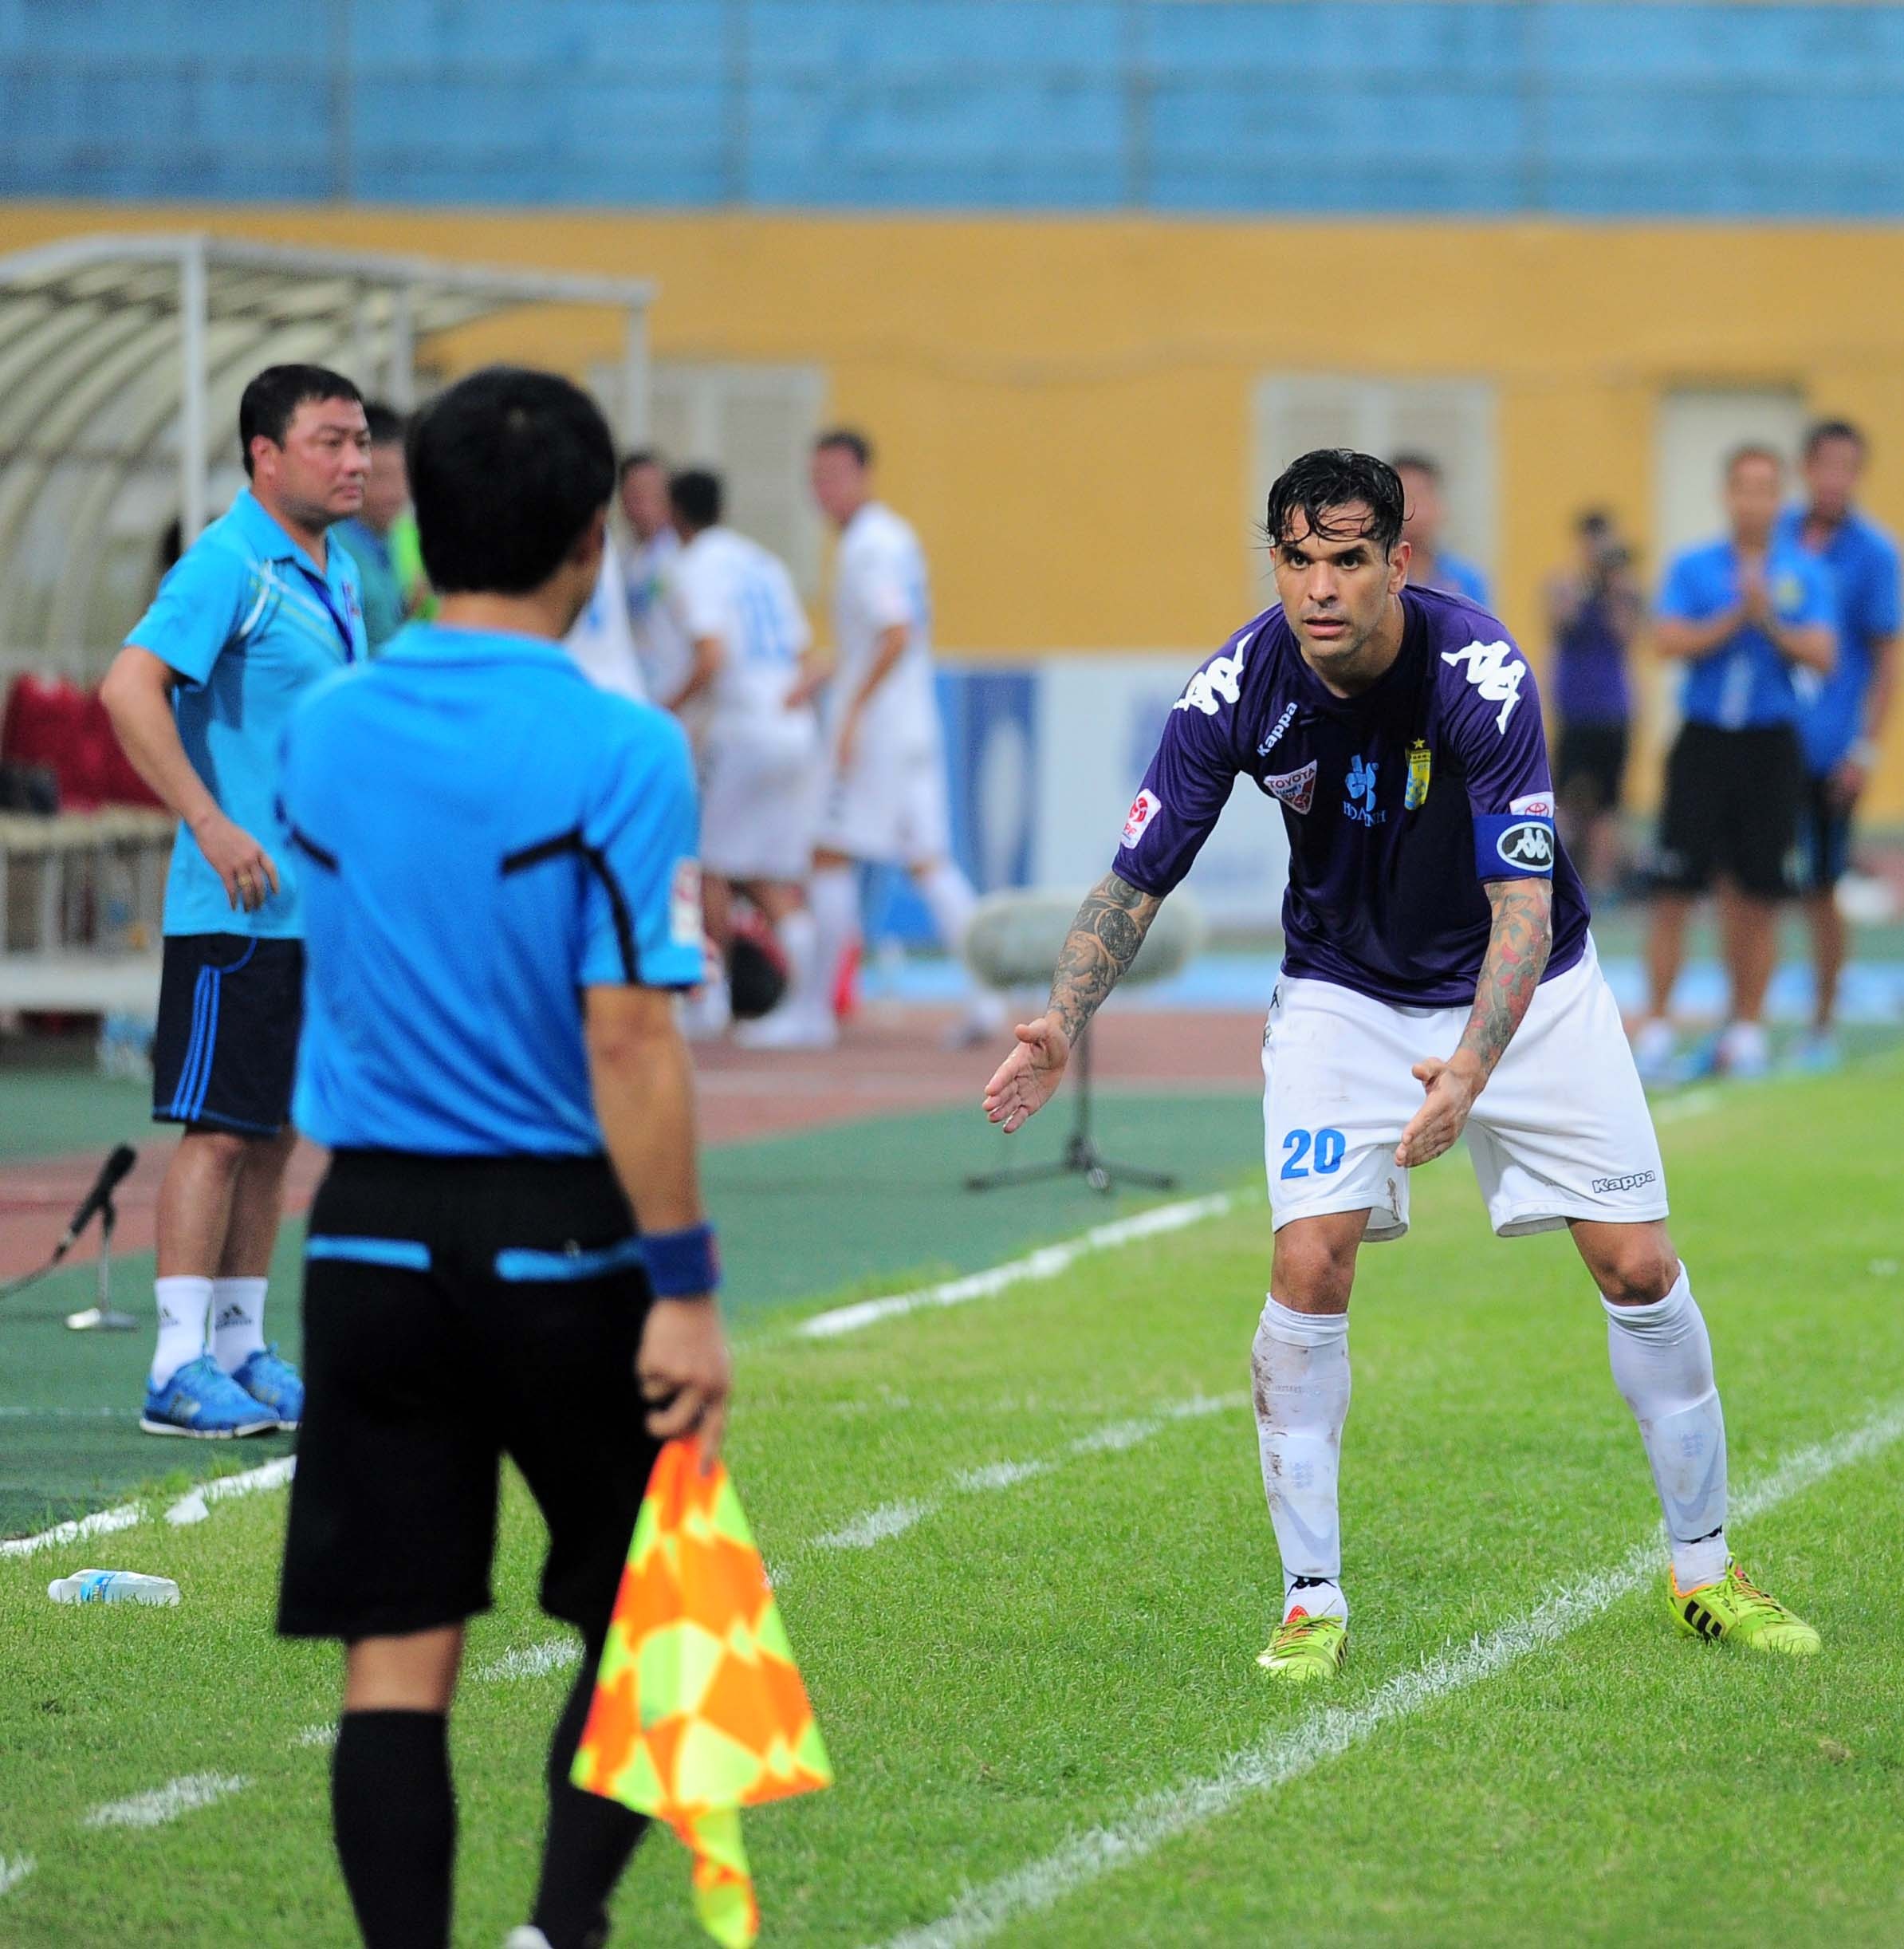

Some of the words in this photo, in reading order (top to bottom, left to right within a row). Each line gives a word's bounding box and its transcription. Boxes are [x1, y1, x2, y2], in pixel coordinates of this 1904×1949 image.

[1257, 703, 1298, 757] Kappa
[1268, 768, 1316, 789] TOYOTA
[1280, 1128, 1346, 1180] 20
[1591, 1170, 1656, 1194] Kappa
